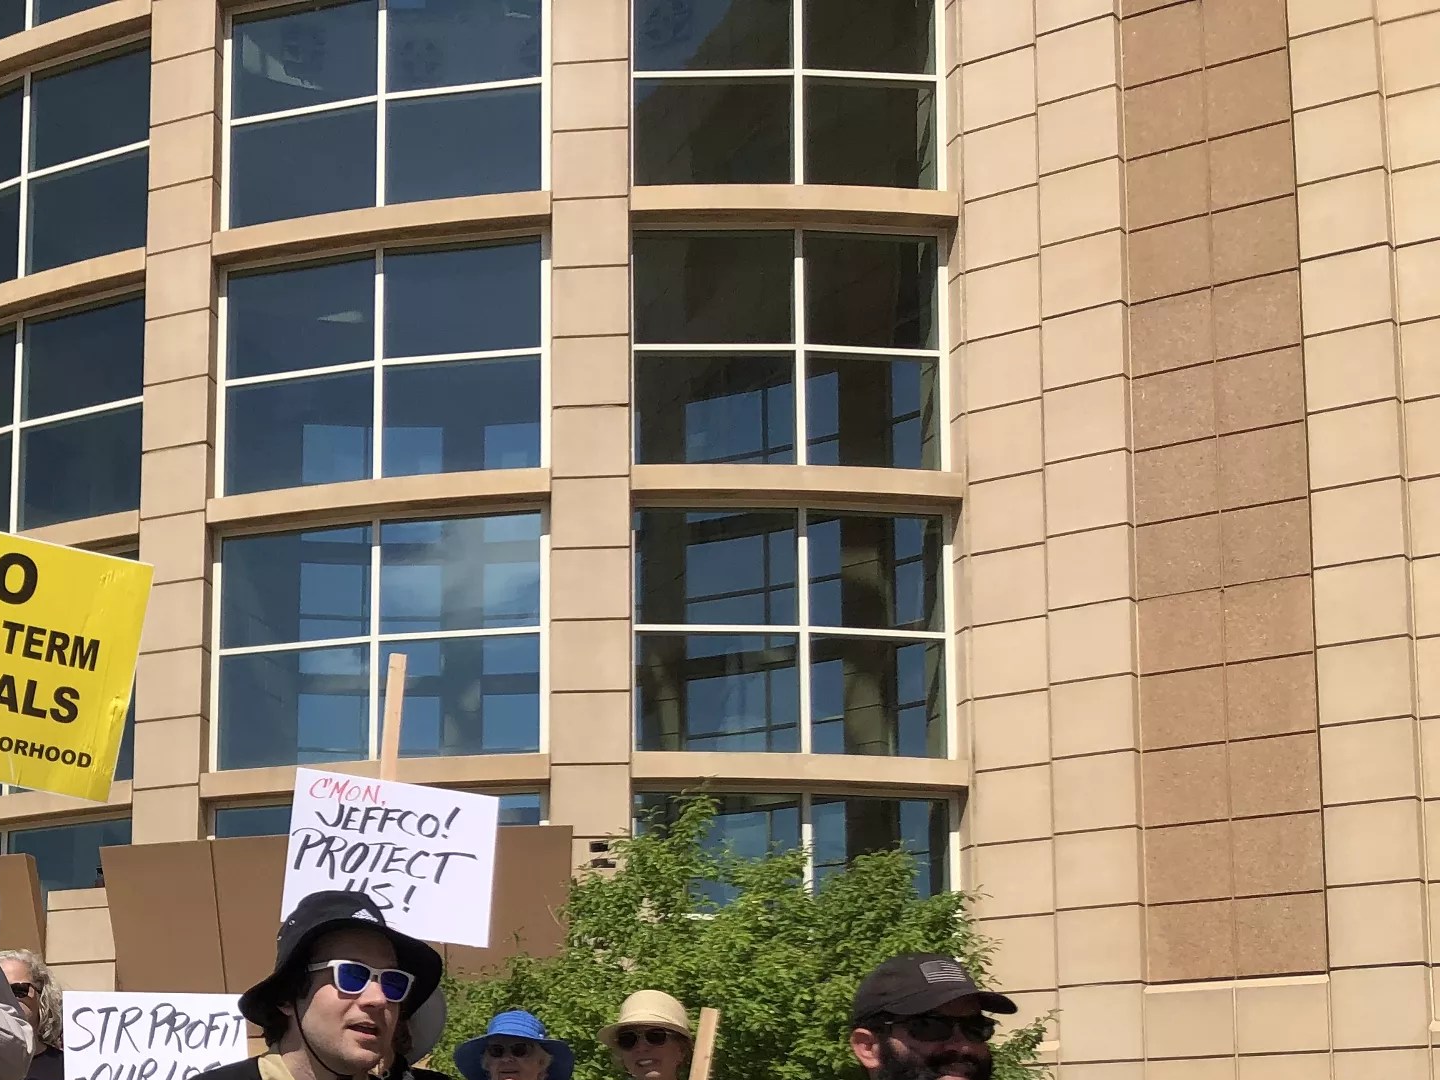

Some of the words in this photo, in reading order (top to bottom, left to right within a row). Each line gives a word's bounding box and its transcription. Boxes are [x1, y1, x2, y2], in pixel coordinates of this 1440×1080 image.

[2, 620, 101, 672] TERM
[315, 804, 461, 839] JEFFCO!
[292, 827, 478, 884] PROTECT
[67, 1006, 141, 1055] STR
[147, 1002, 245, 1054] PROFIT
